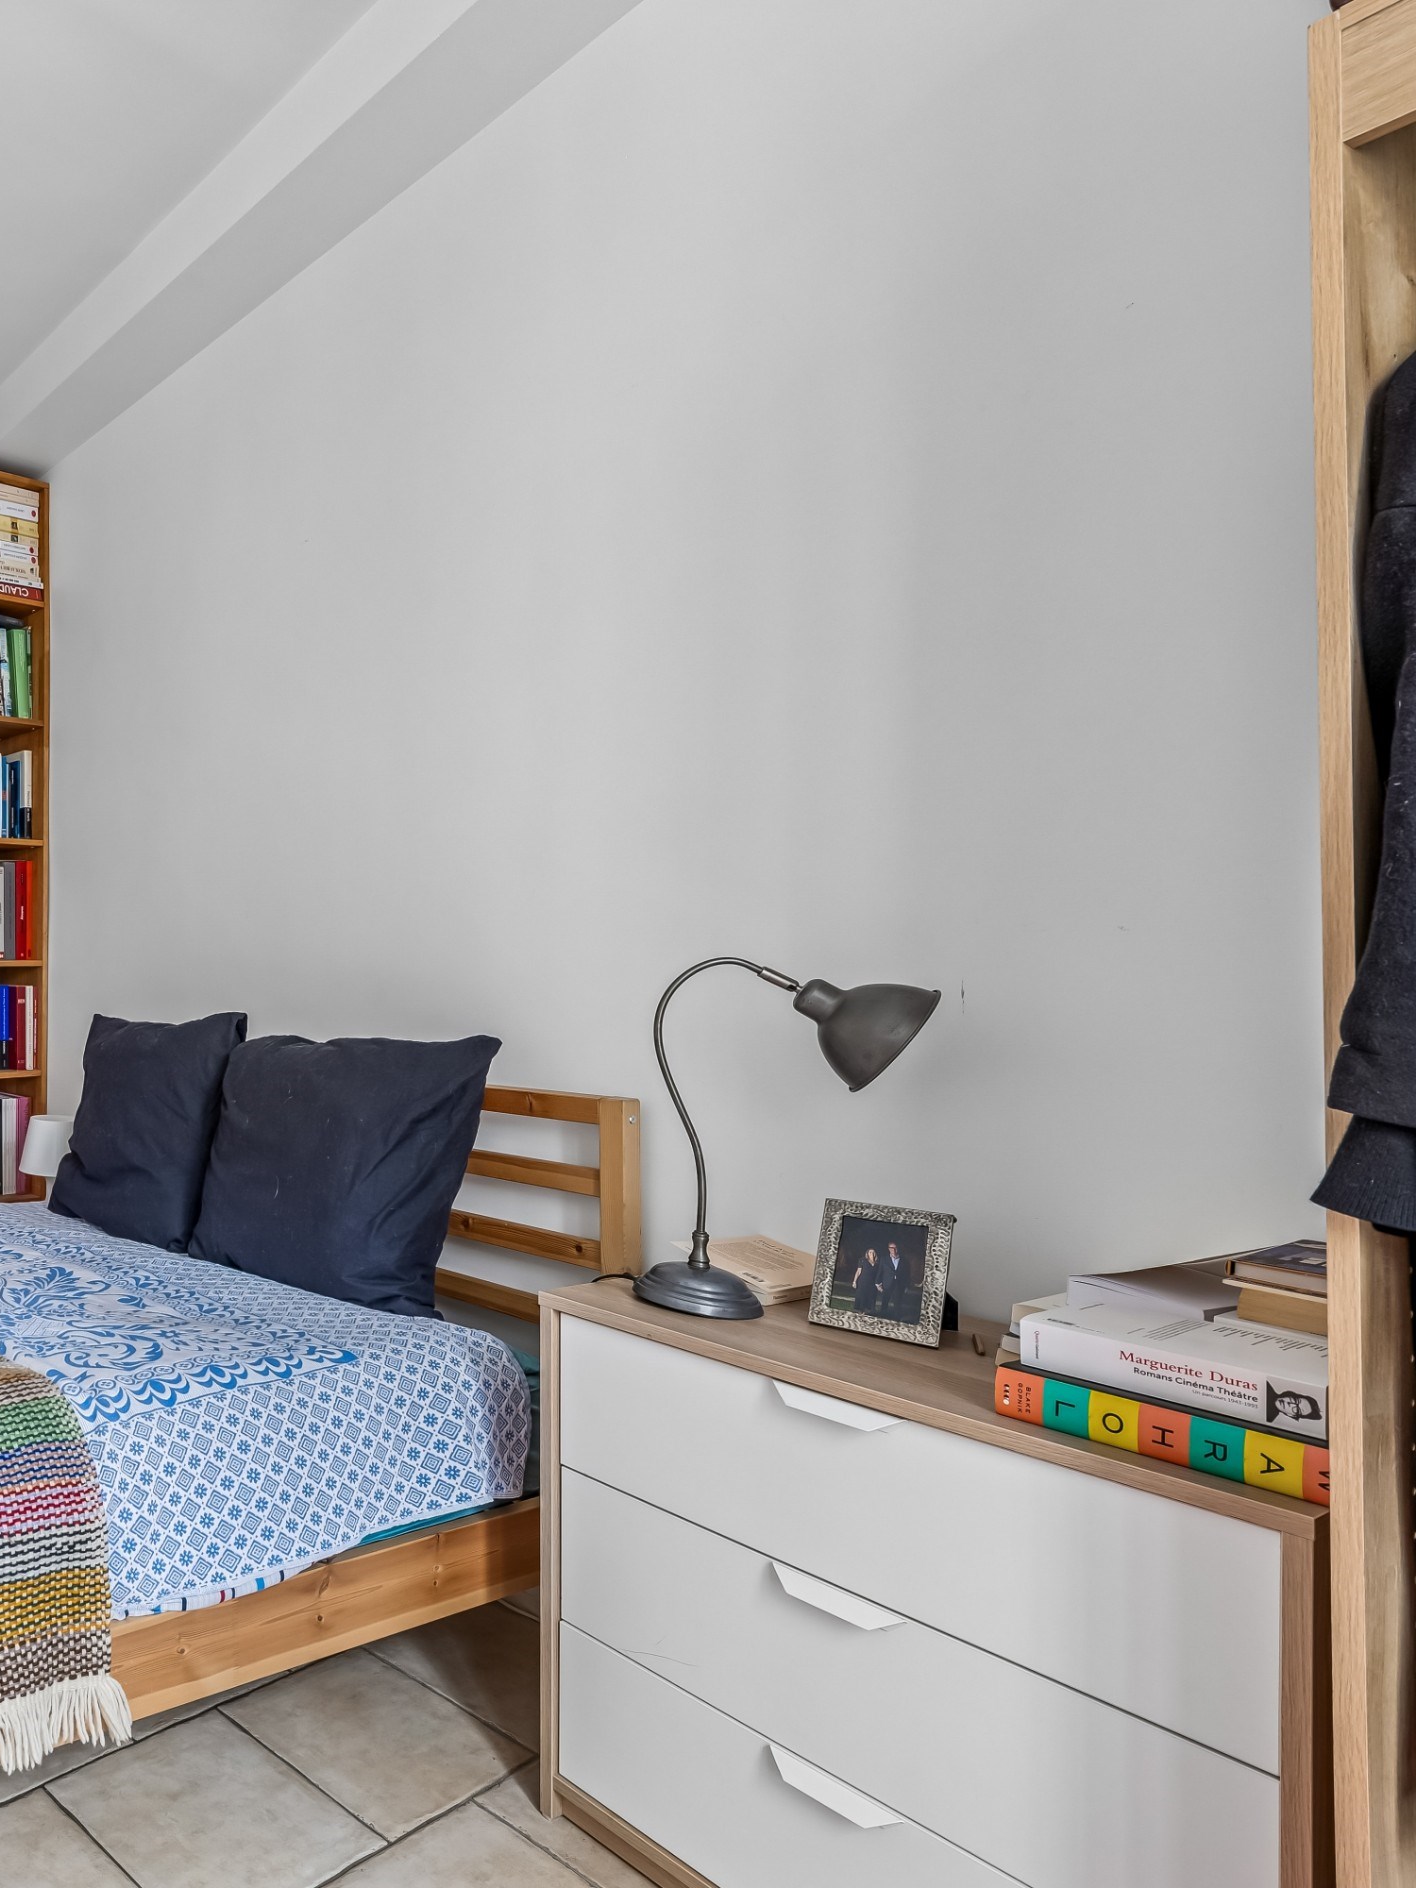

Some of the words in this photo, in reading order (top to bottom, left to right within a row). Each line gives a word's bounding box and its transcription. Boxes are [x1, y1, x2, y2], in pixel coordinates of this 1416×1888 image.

[1119, 1350, 1203, 1378] Marguerite
[1210, 1370, 1259, 1391] Duras
[1133, 1366, 1173, 1382] Romans
[1175, 1376, 1215, 1393] Cinéma
[1217, 1386, 1259, 1403] Théâtre
